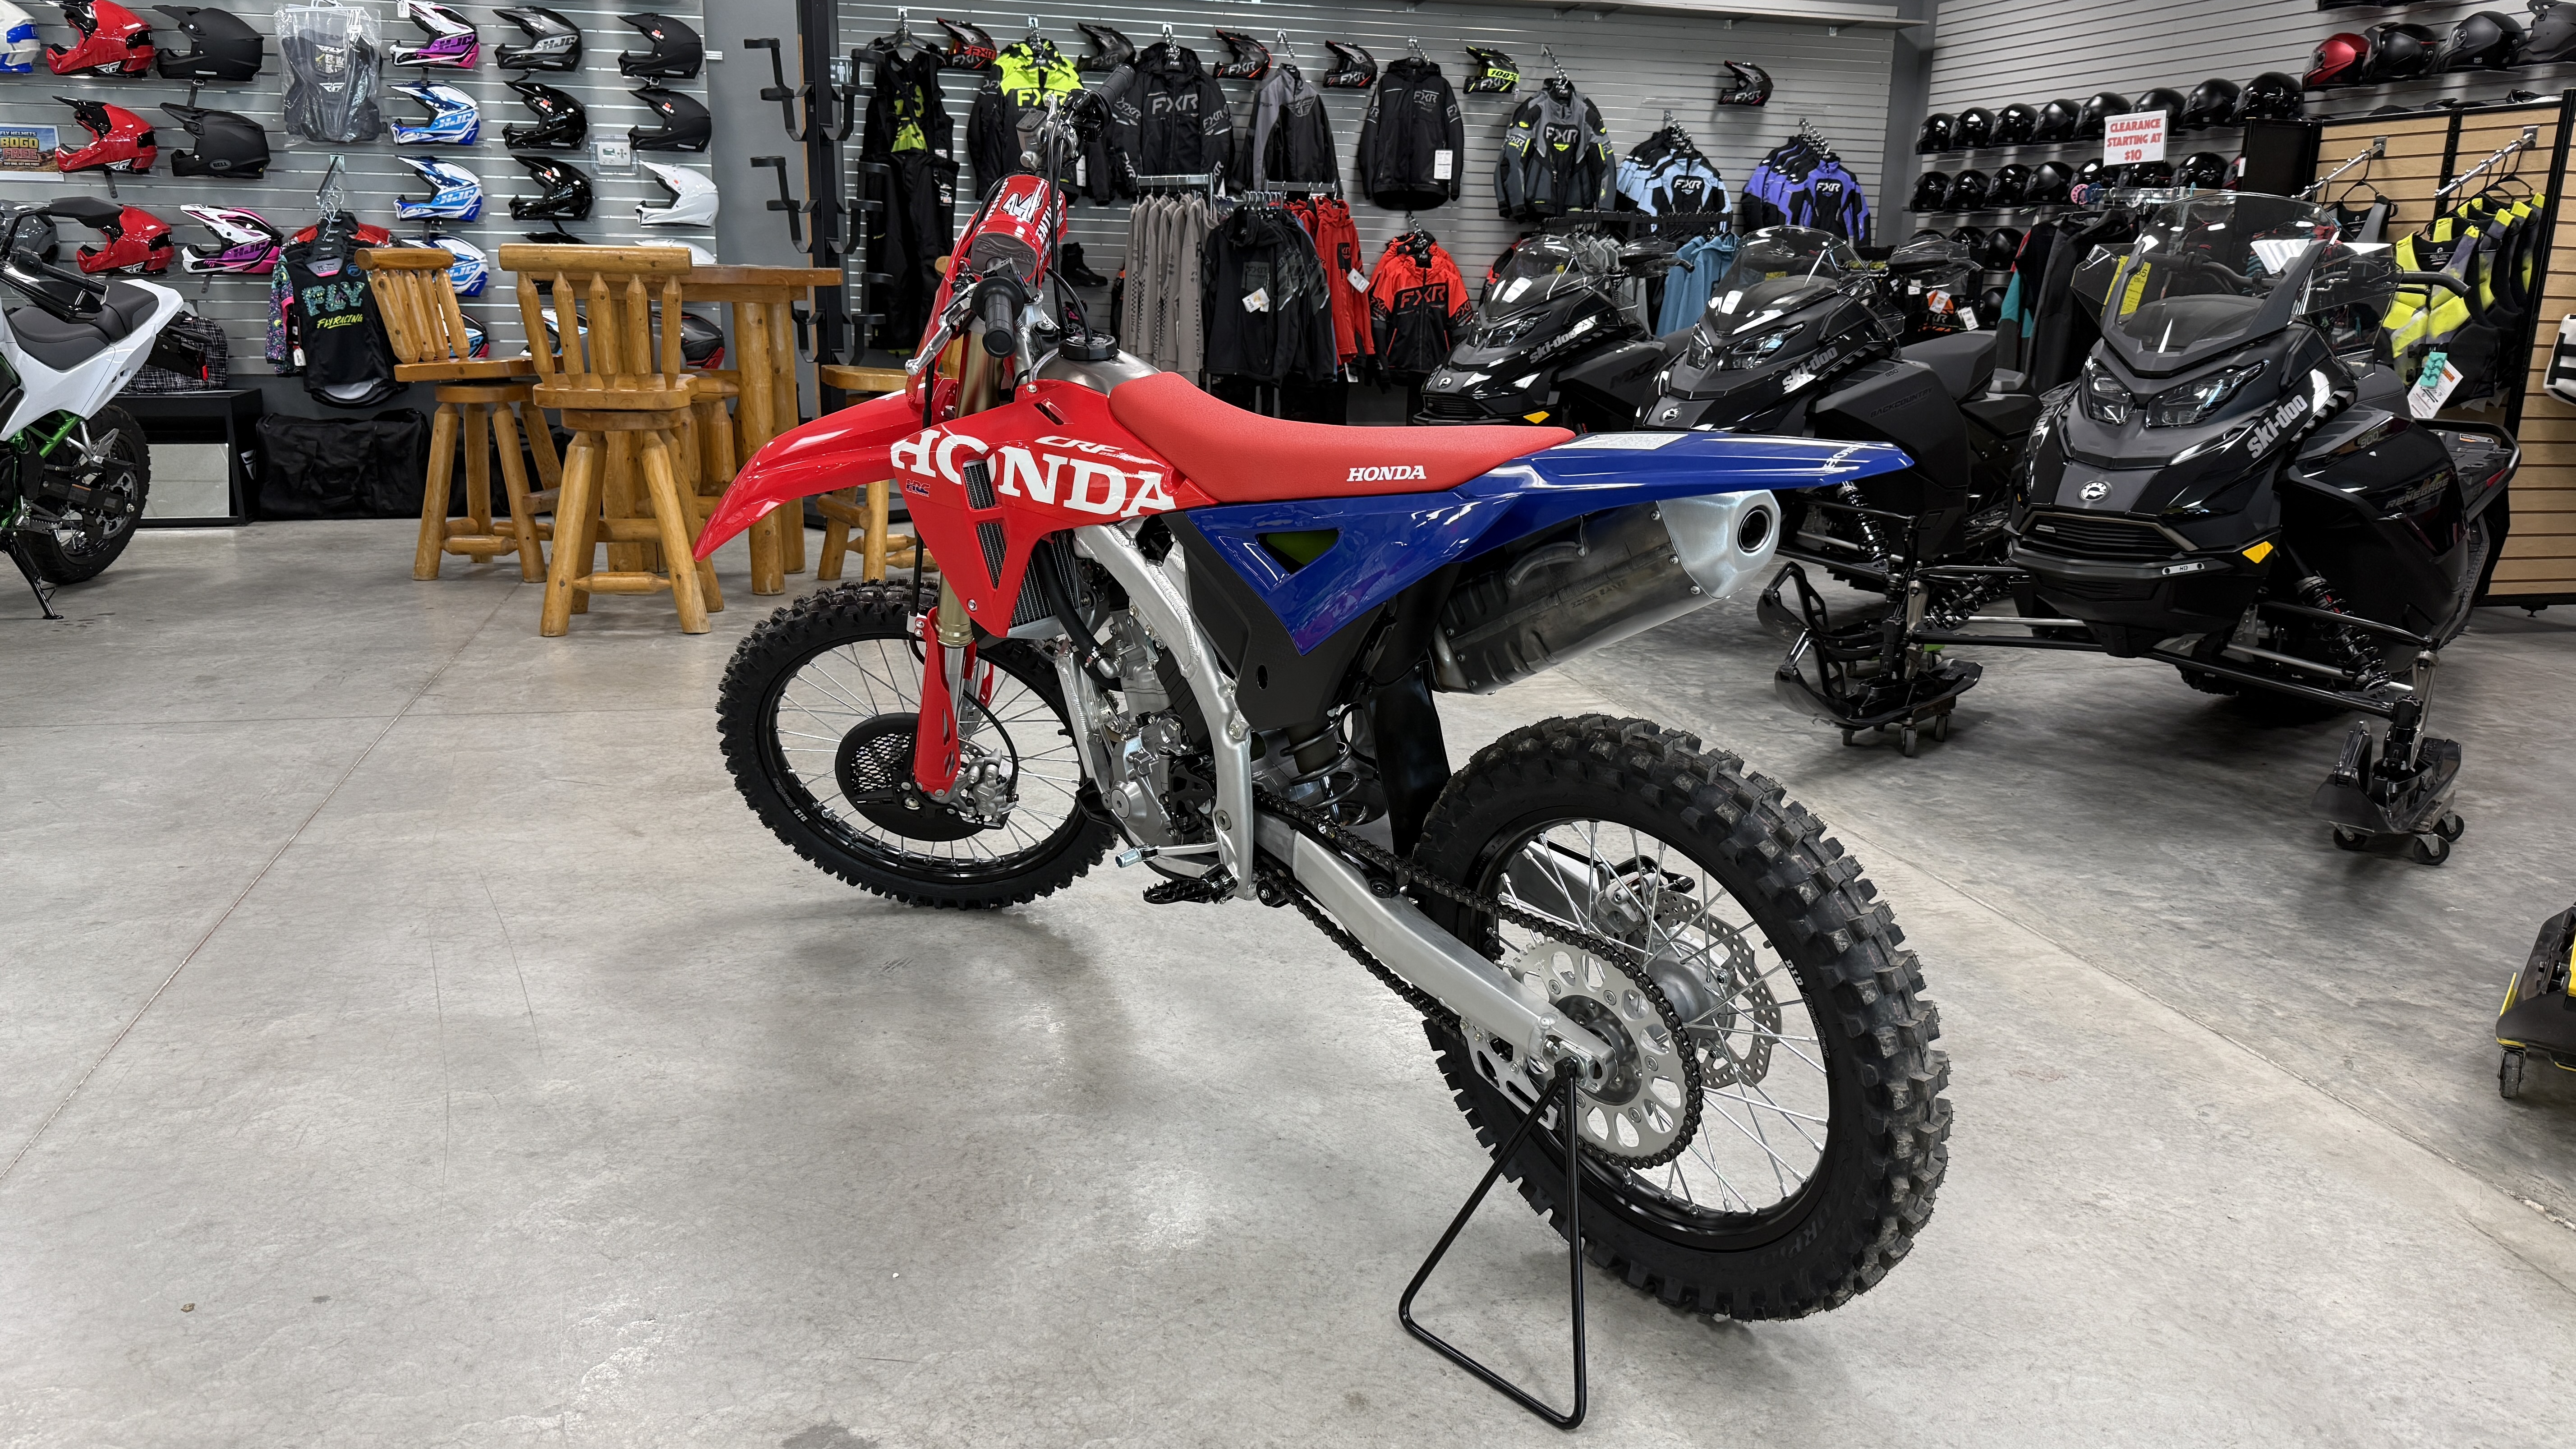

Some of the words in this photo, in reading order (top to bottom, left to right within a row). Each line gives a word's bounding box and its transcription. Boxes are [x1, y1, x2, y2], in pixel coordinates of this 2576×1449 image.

[439, 34, 473, 50] HJC
[541, 37, 576, 51] HJC
[971, 47, 993, 58] FXR
[1092, 54, 1118, 68] FXR
[1228, 61, 1256, 75] FXR
[1340, 72, 1365, 84] FXR
[1490, 70, 1518, 80] 100%
[1413, 91, 1437, 103] FXR
[1734, 90, 1761, 102] FXR
[1123, 102, 1141, 119] FXR
[1152, 94, 1198, 114] FXR
[439, 113, 472, 128] HJC
[1203, 110, 1223, 129] FXR
[2110, 118, 2161, 133] CLEARANCE
[1546, 126, 1578, 143] FXR
[2107, 134, 2148, 147] STARTING
[2150, 133, 2162, 143] AT
[0, 137, 39, 148] BOGO
[2, 148, 38, 160] FREE
[2125, 149, 2142, 161] $10
[1674, 179, 1702, 189] FXR
[1816, 183, 1841, 192] FXR
[440, 189, 474, 204] HJC
[234, 242, 266, 257] HJC
[302, 281, 365, 317] FLY
[1400, 285, 1446, 308] FXR
[1456, 302, 1471, 321] FXR
[317, 317, 333, 328] FLY
[333, 313, 363, 325] RACING
[1870, 386, 1933, 418] BACKCOUNTRY
[2247, 395, 2308, 459] ski-doo
[1035, 436, 1123, 454] CRF
[2360, 431, 2379, 449] 900
[890, 429, 1176, 517] HONDA
[1346, 465, 1427, 482] HONDA
[906, 478, 930, 495] HRC
[2385, 478, 2449, 509] RENEGADE
